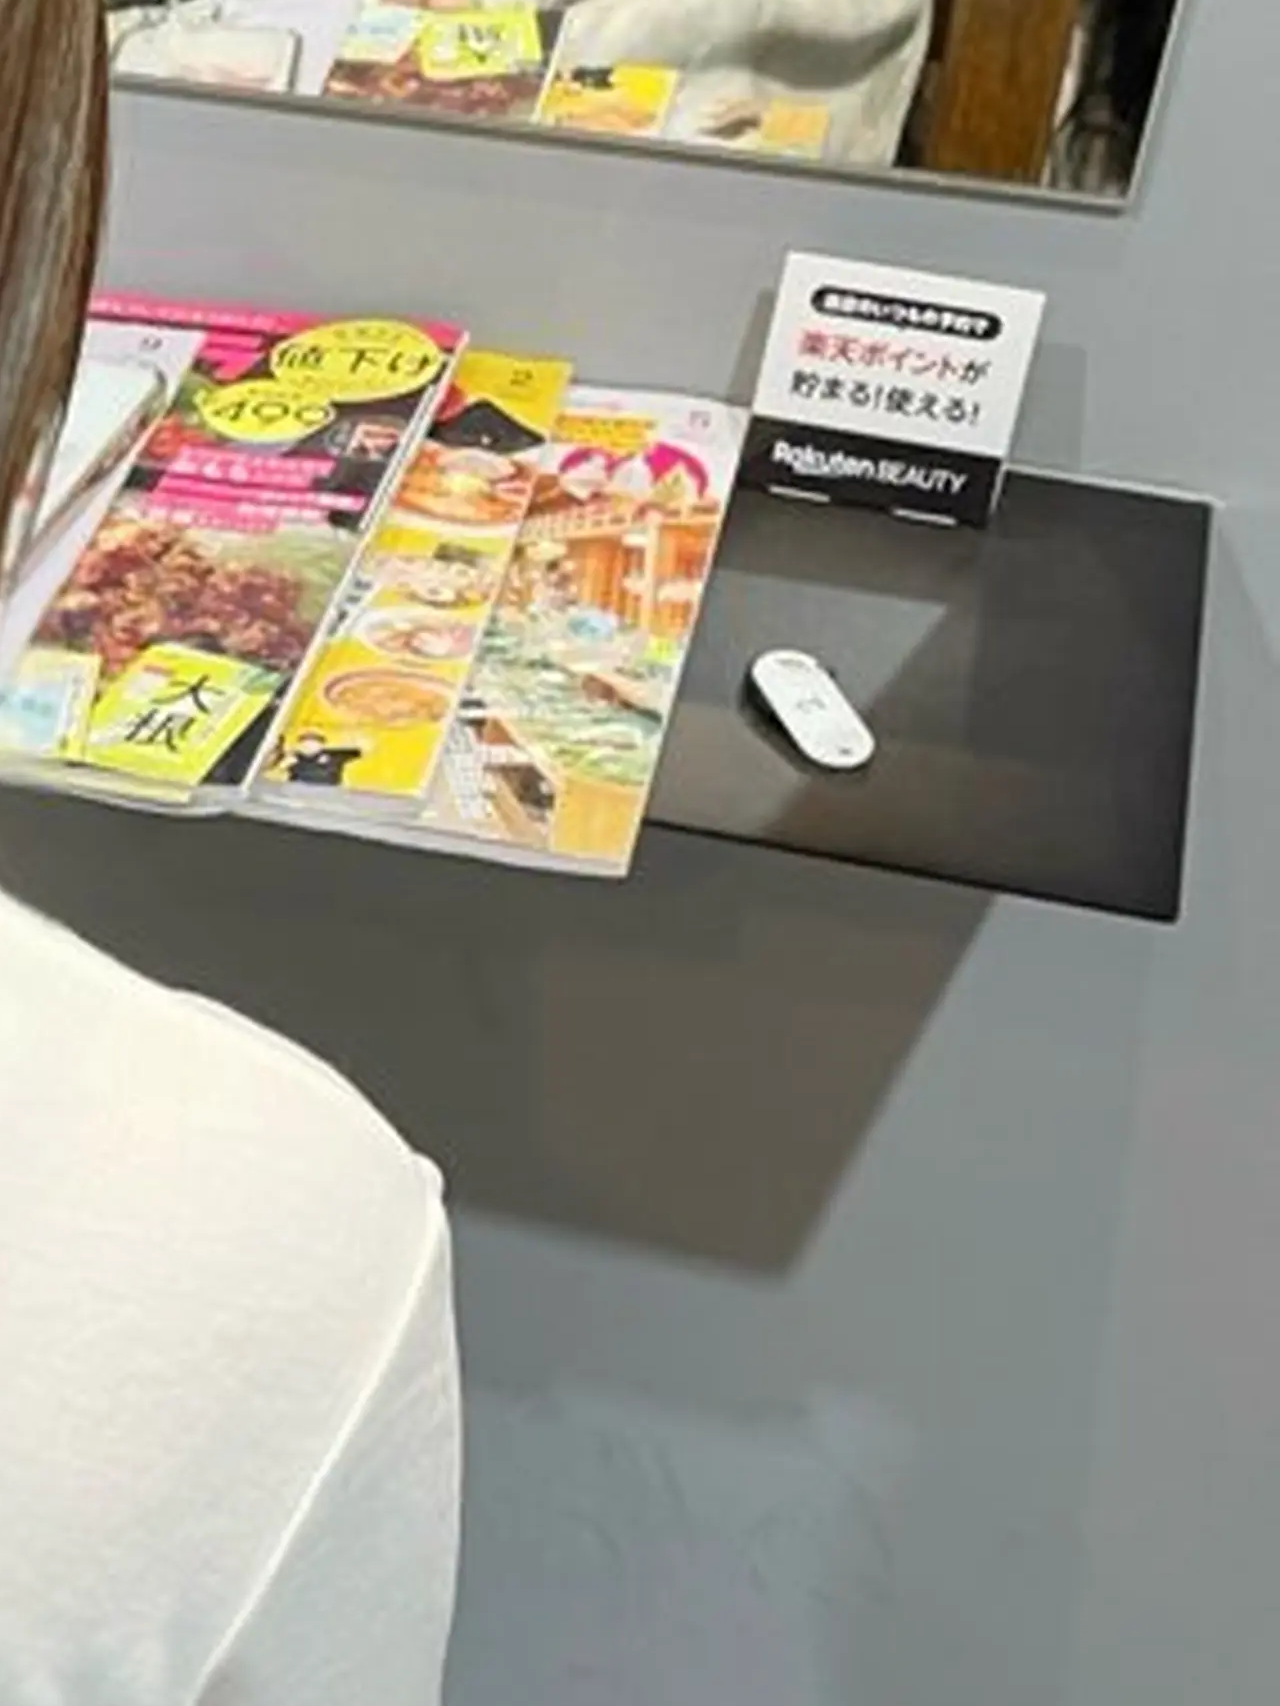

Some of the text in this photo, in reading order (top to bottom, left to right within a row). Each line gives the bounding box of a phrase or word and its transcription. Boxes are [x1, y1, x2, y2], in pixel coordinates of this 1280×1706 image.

[800, 329, 991, 385] 楽天ポイントが
[878, 460, 968, 494] BEAUTY
